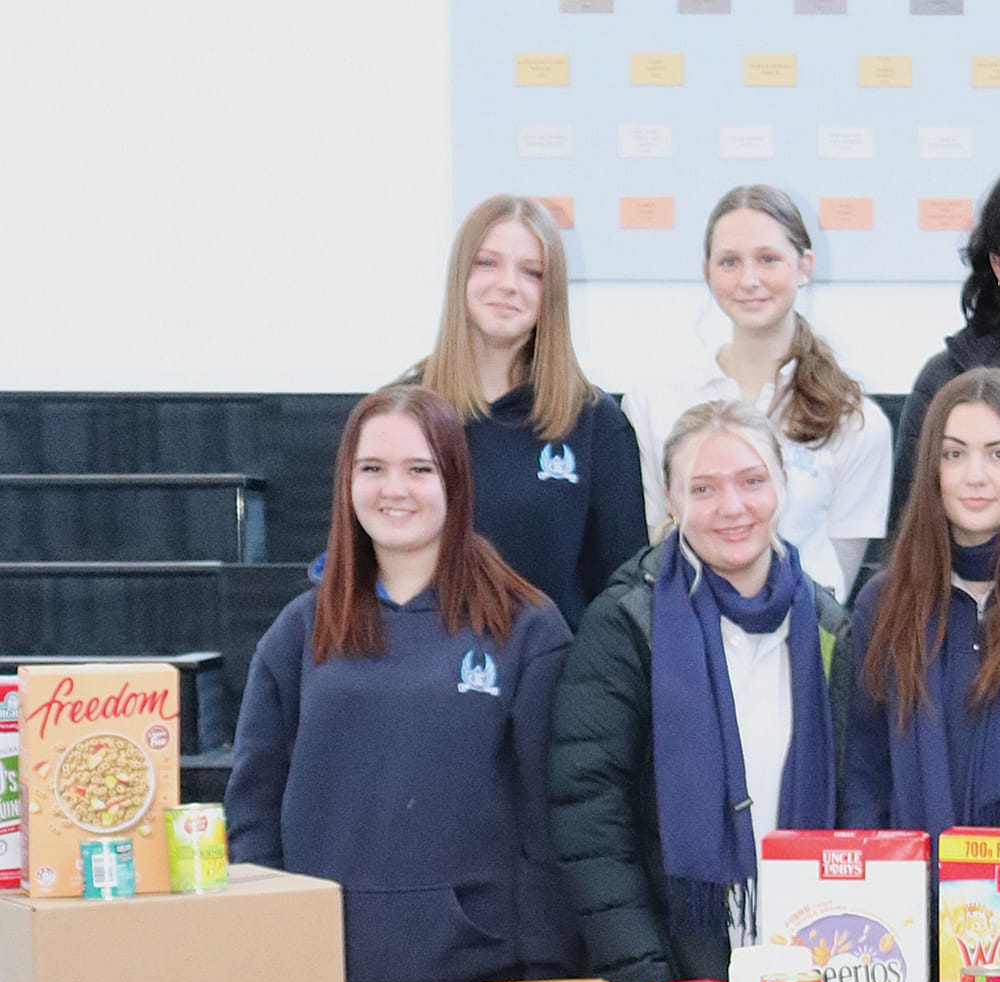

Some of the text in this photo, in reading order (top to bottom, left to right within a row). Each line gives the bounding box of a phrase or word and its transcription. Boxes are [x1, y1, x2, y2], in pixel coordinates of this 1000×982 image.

[26, 677, 181, 740] freedom
[964, 841, 993, 858] 700g
[822, 851, 862, 864] UNCLE
[822, 864, 862, 877] TOBYS
